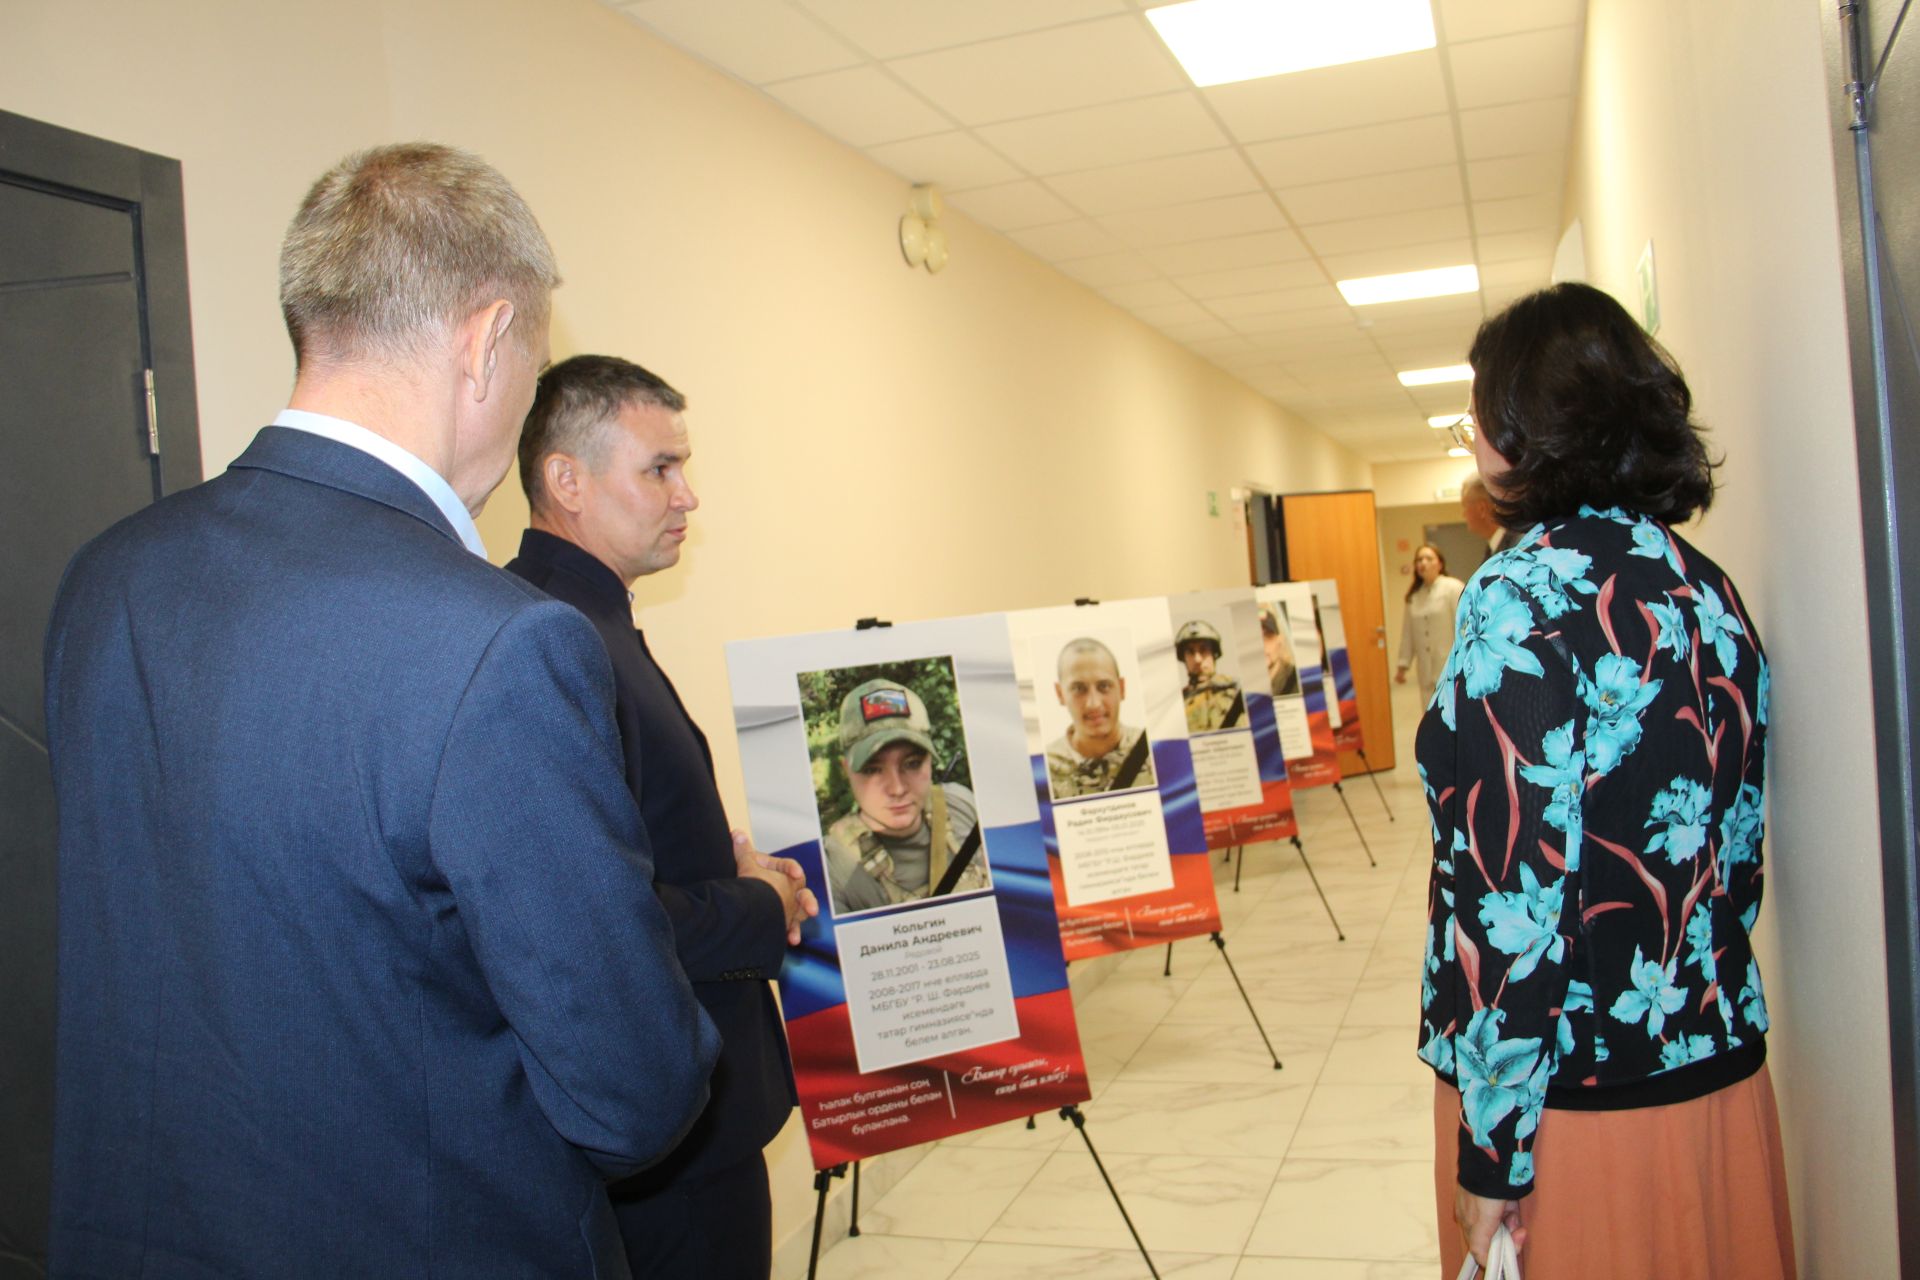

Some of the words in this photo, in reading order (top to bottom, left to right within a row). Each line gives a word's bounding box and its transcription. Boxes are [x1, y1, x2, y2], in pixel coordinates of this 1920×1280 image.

[893, 919, 945, 934] Кольгин
[860, 940, 908, 957] Данила
[913, 926, 981, 945] Андреевич
